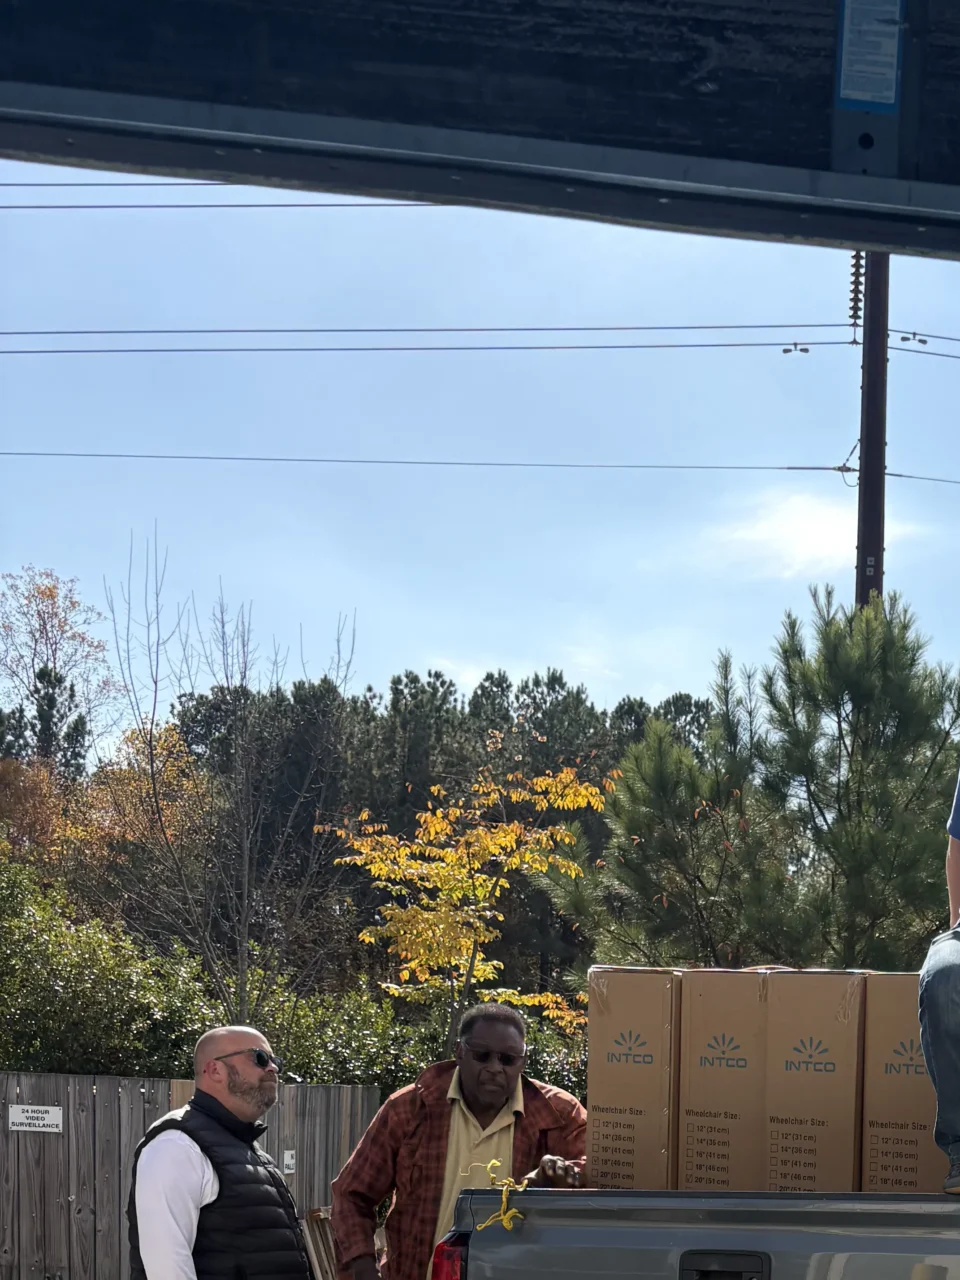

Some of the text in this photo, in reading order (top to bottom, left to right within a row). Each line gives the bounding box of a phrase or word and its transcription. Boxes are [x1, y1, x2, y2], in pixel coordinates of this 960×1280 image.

[607, 1052, 653, 1064] INTCO
[700, 1056, 747, 1068] INTCO
[785, 1061, 836, 1073] INTCO
[885, 1063, 928, 1075] INTC
[592, 1105, 627, 1115] Wheelchair
[685, 1109, 721, 1118] Wheelchair
[769, 1116, 808, 1125] Wheelchair
[869, 1121, 909, 1130] Wheelchair
